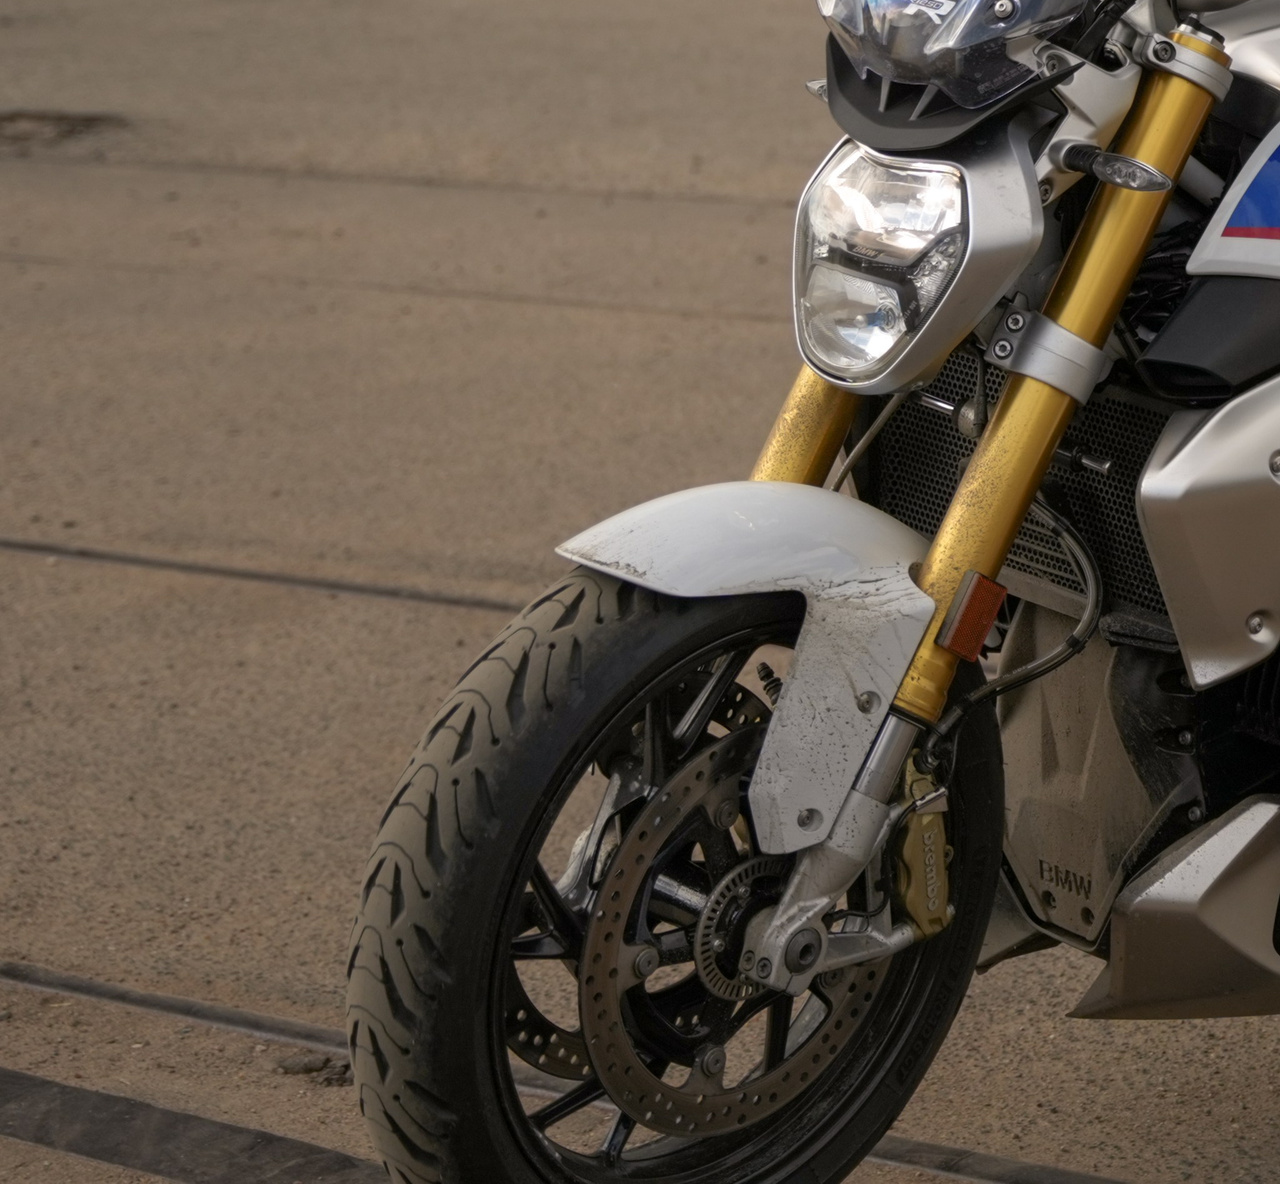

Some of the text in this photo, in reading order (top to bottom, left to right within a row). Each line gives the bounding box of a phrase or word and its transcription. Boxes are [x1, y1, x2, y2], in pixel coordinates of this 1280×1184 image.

[852, 245, 879, 257] BMW
[922, 829, 939, 911] brembo
[1039, 859, 1092, 900] BMW
